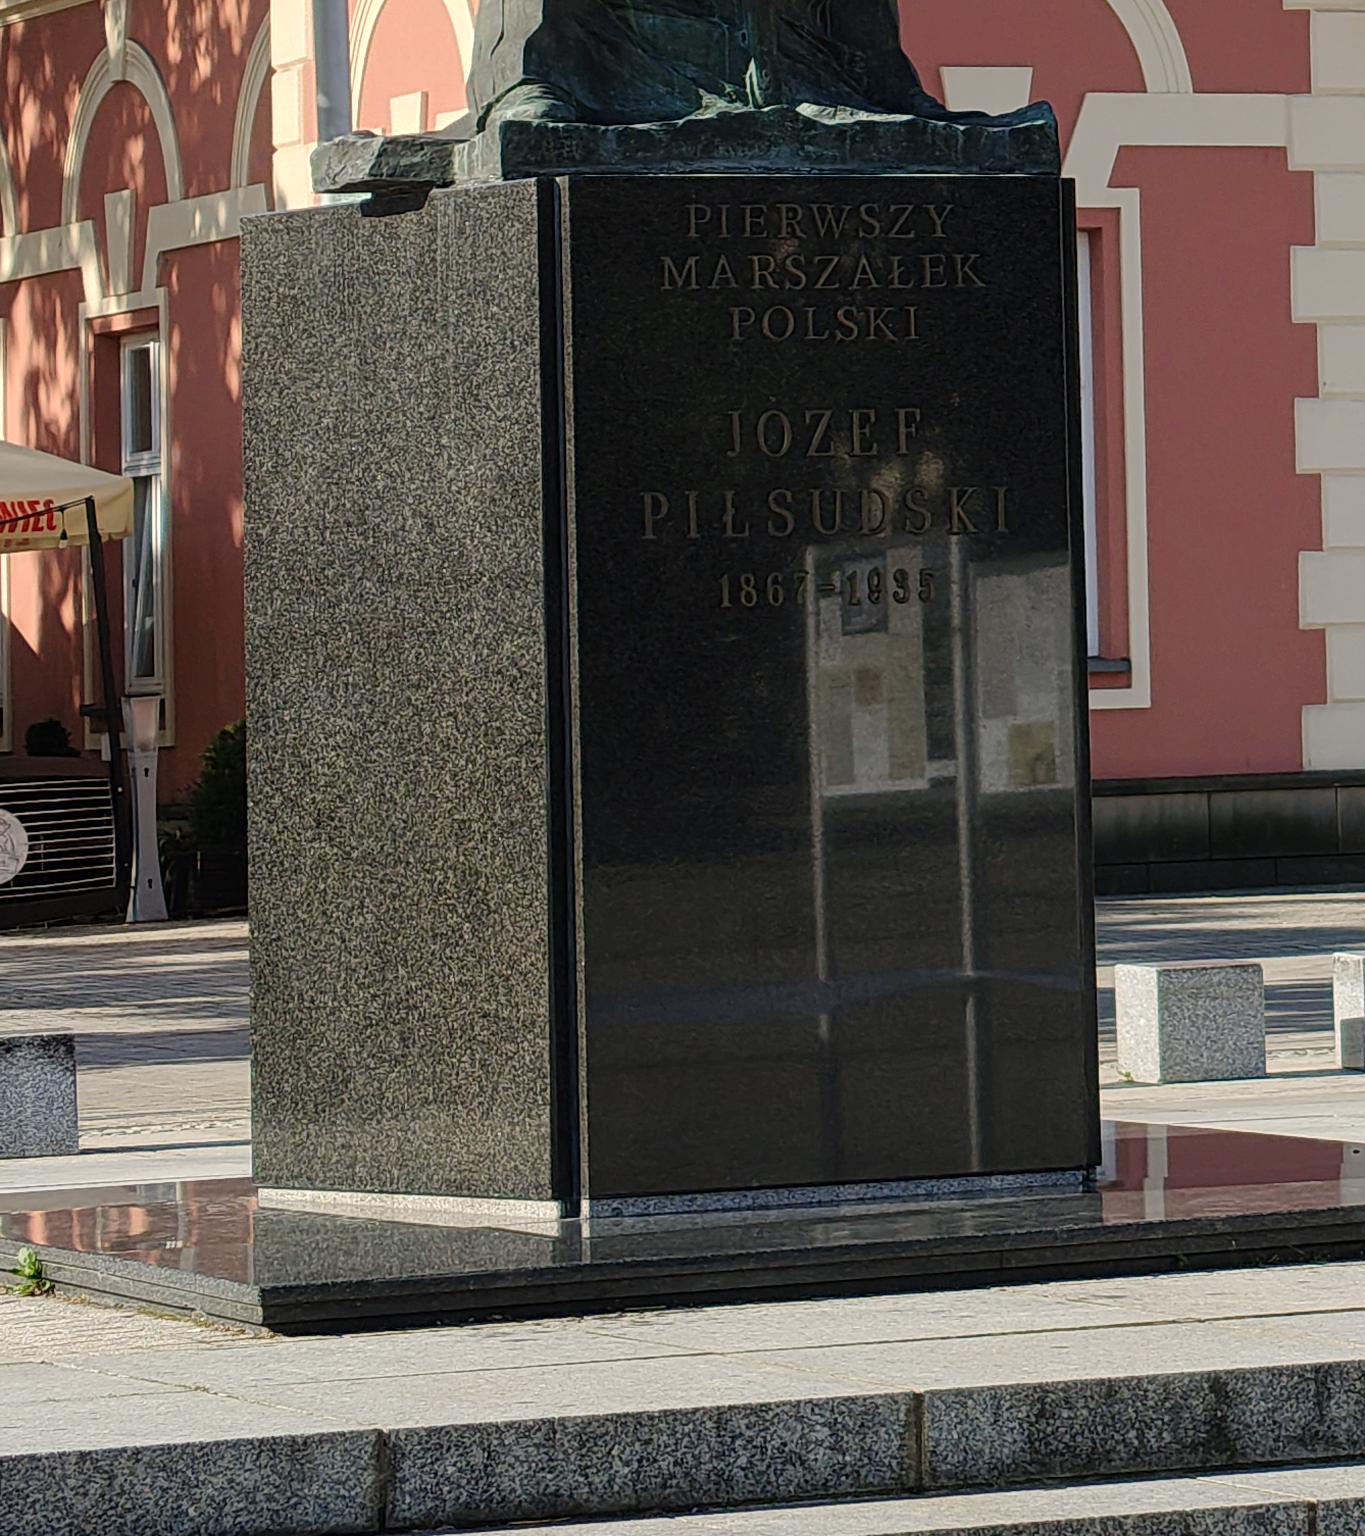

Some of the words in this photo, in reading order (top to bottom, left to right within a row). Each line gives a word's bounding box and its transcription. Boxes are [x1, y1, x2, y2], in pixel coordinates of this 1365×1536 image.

[686, 203, 956, 240] PIERWSZY
[659, 252, 987, 292] MARSZAŁEK
[729, 305, 921, 342] POLSKI
[639, 485, 1010, 540] PIŁSUDSKI
